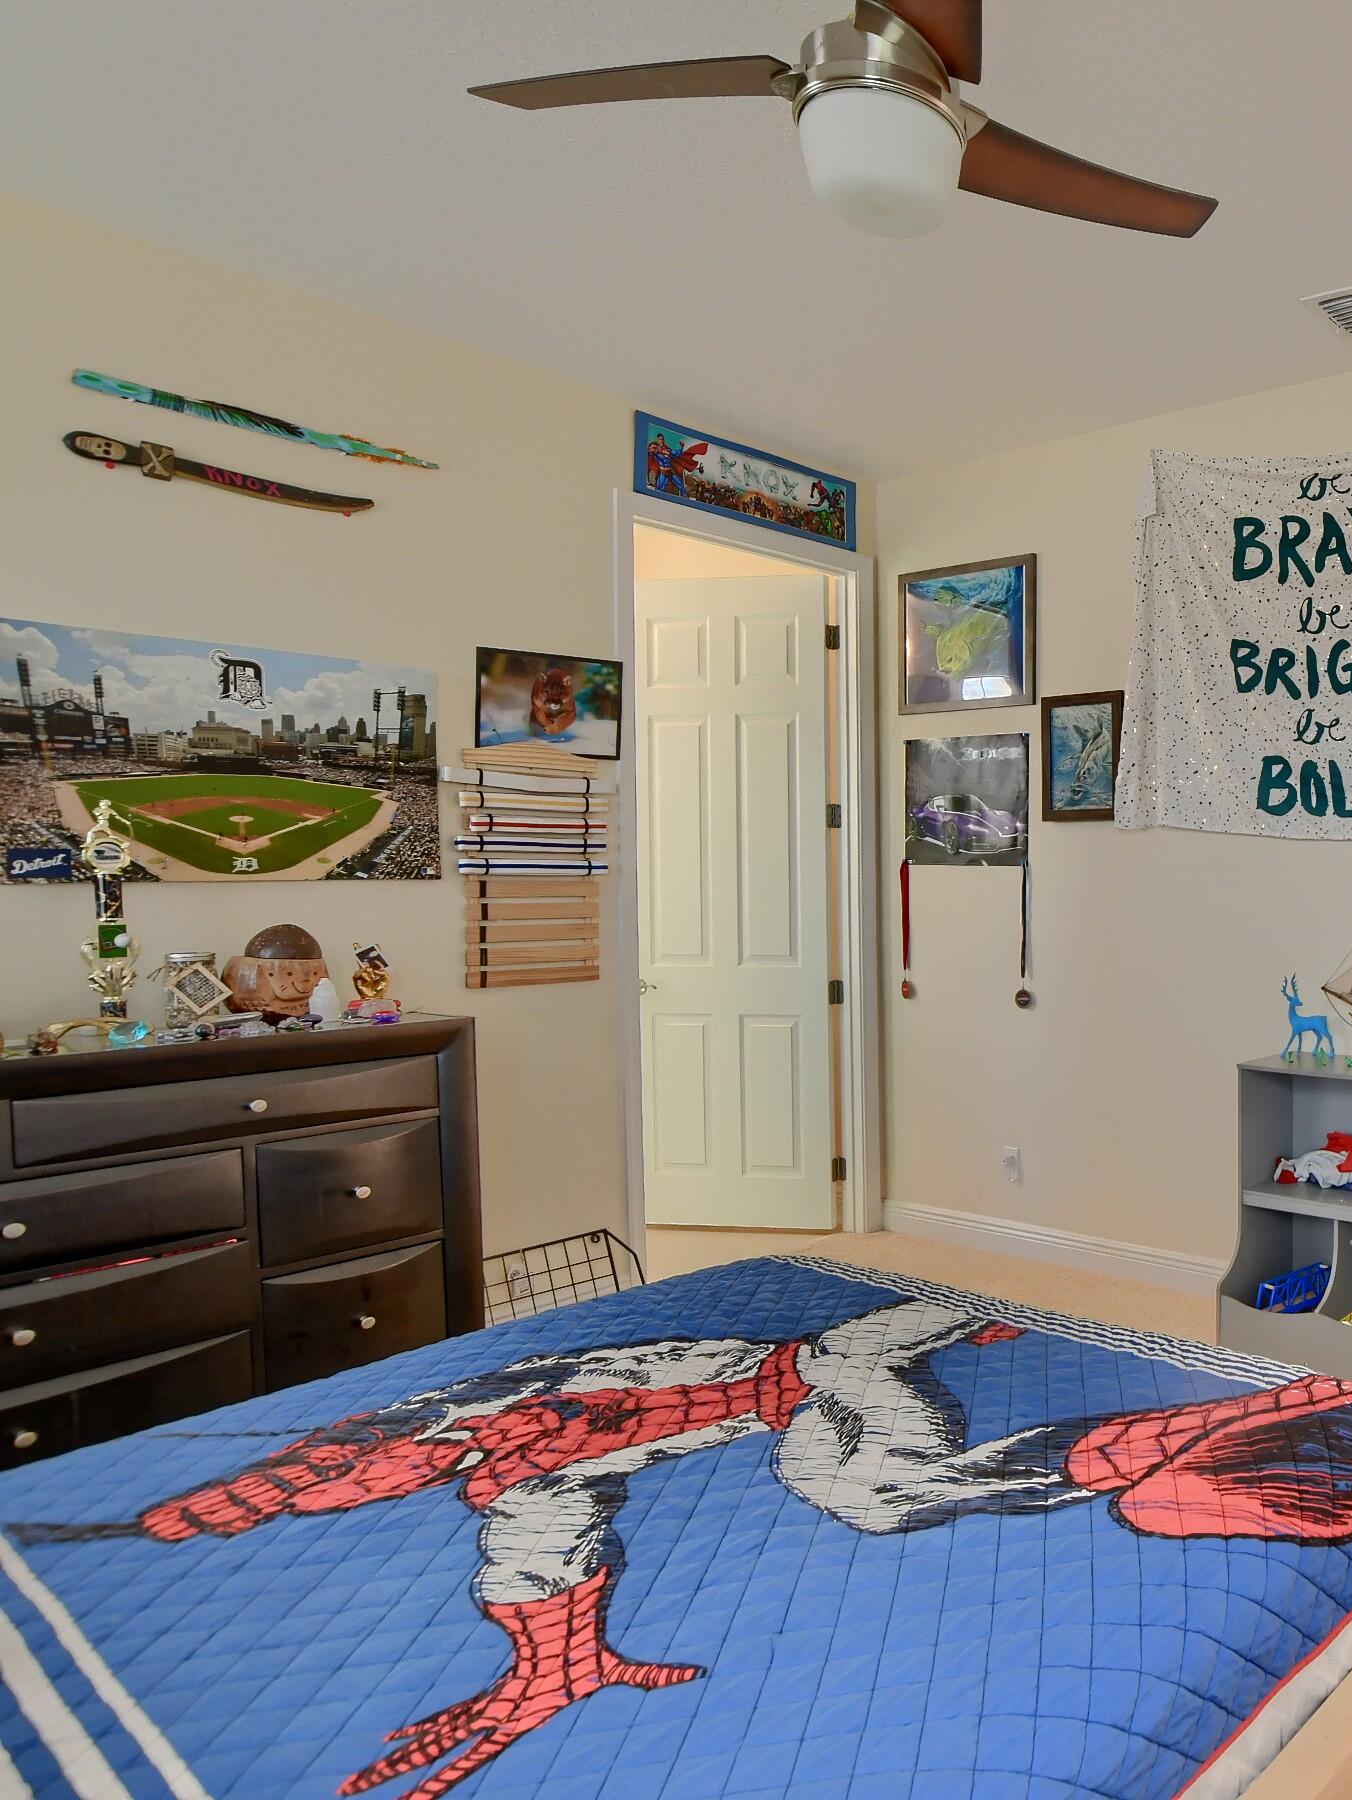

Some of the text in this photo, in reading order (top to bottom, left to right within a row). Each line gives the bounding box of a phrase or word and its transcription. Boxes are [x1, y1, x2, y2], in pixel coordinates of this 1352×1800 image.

[203, 465, 282, 497] KNOX
[719, 454, 799, 502] KNOX
[1297, 597, 1350, 634] be
[1293, 708, 1346, 745] be
[10, 853, 66, 875] Detroit
